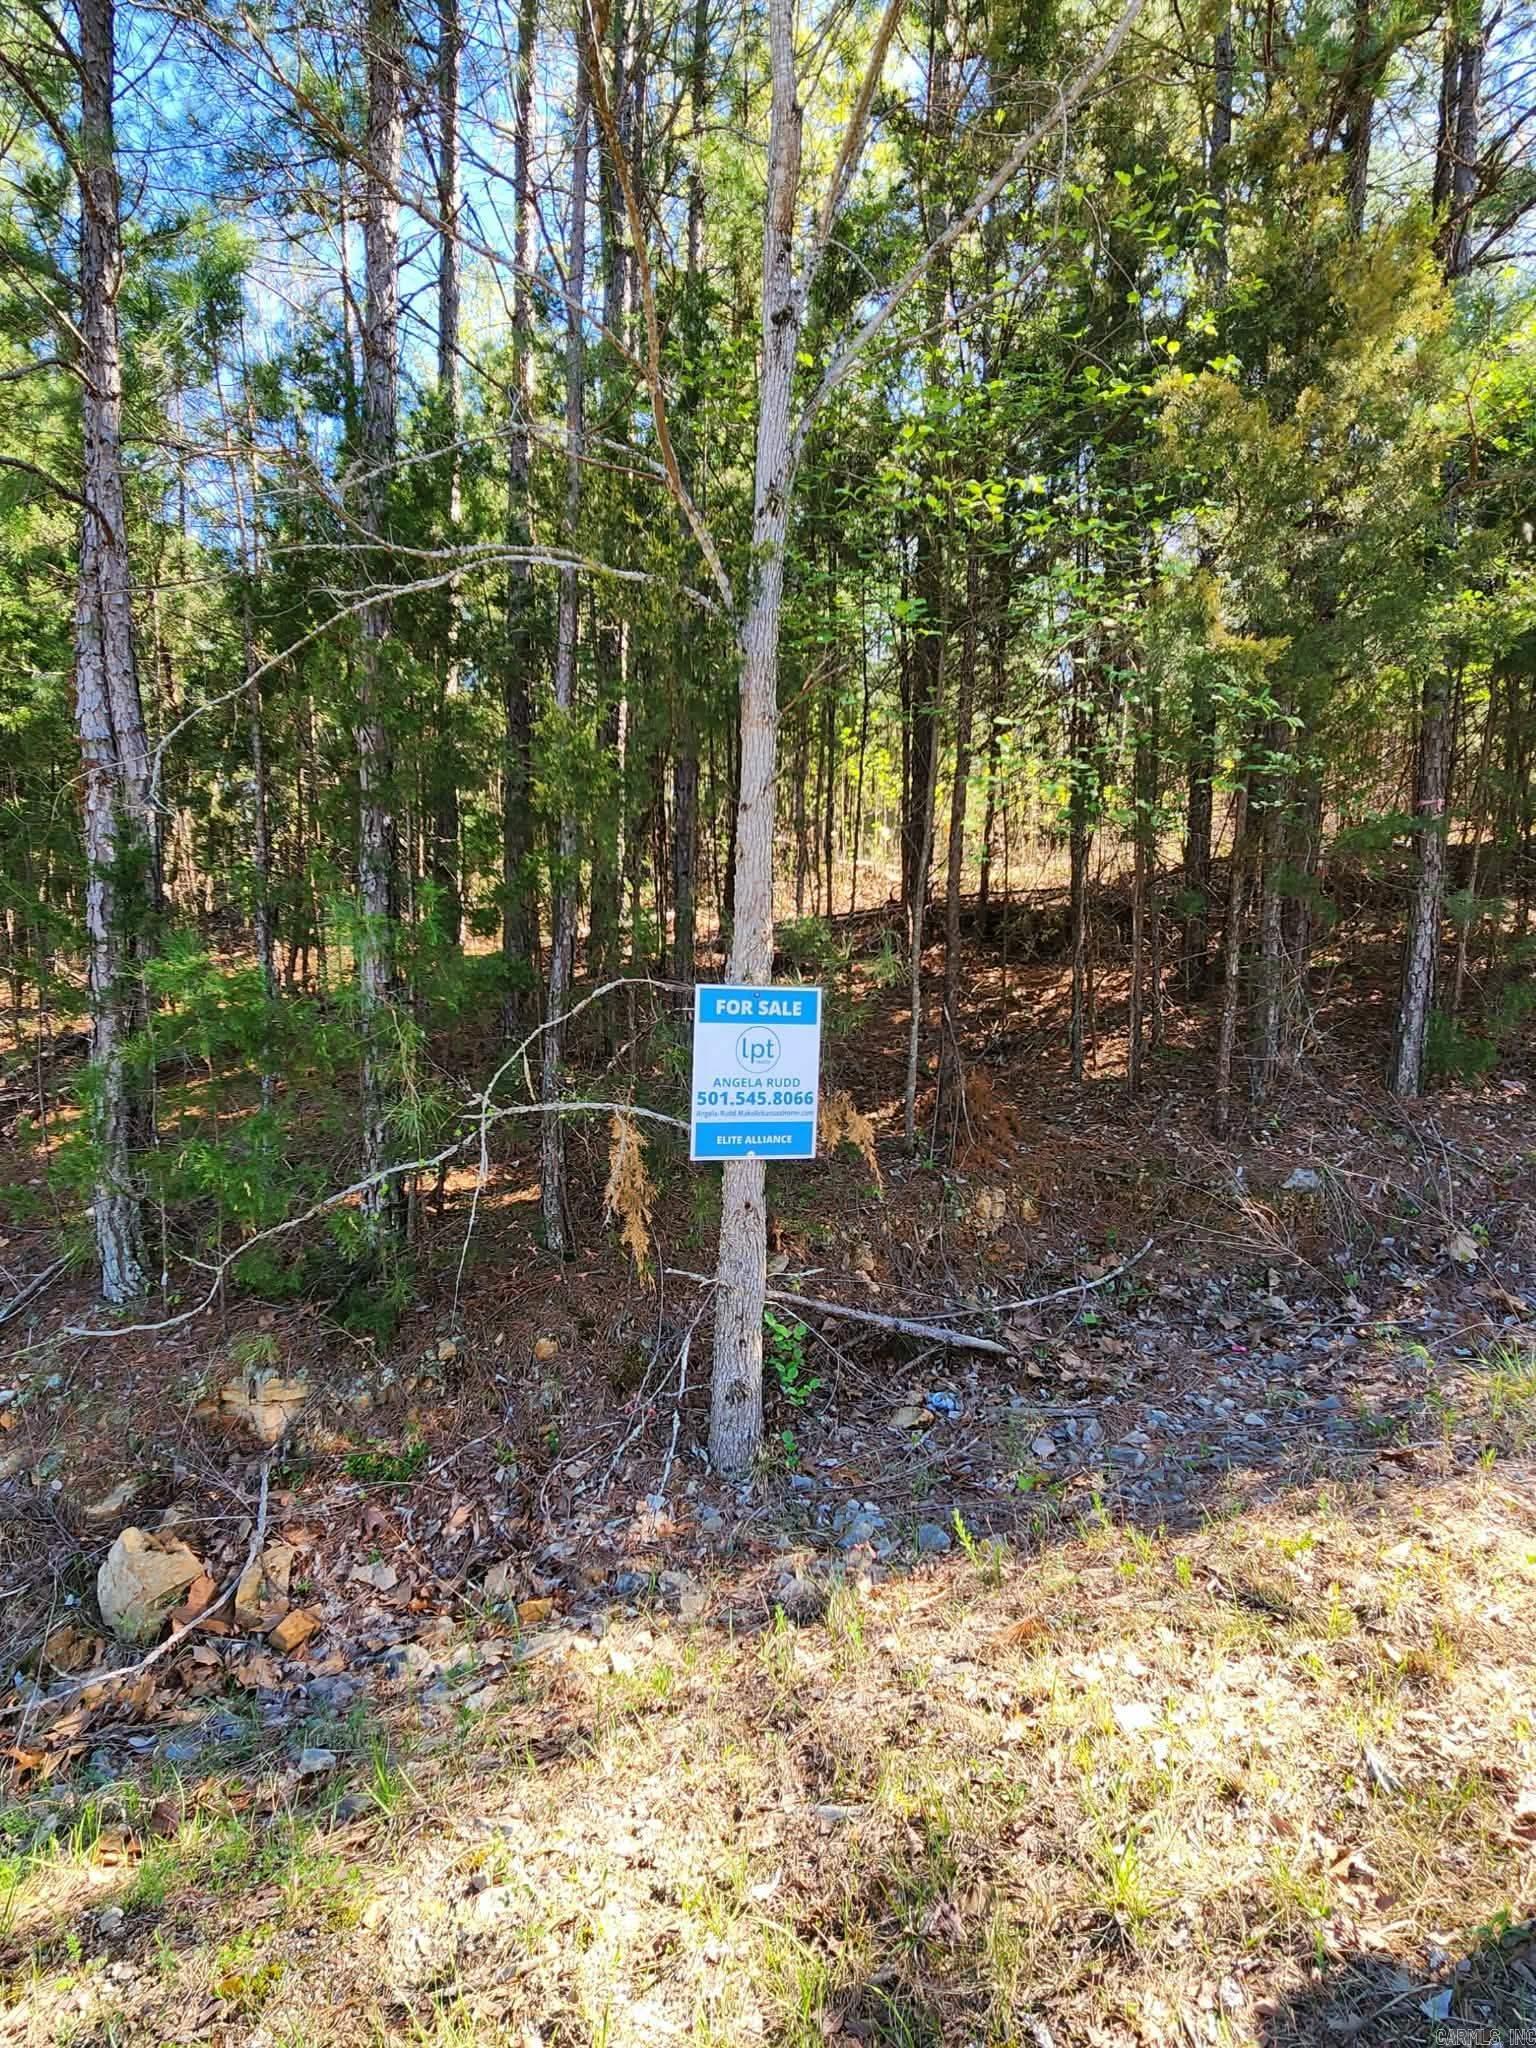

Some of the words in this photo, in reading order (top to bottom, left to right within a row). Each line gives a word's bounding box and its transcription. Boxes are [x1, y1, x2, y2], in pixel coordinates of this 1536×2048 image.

[716, 1000, 753, 1016] FOR
[758, 1000, 803, 1017] SALE
[742, 1037, 774, 1064] lpt
[713, 1077, 763, 1088] ANGELA
[766, 1077, 801, 1088] RUDD
[696, 1091, 814, 1106] 501.545.8066
[716, 1135, 743, 1145] ELITE
[745, 1135, 793, 1145] ALLIANCE
